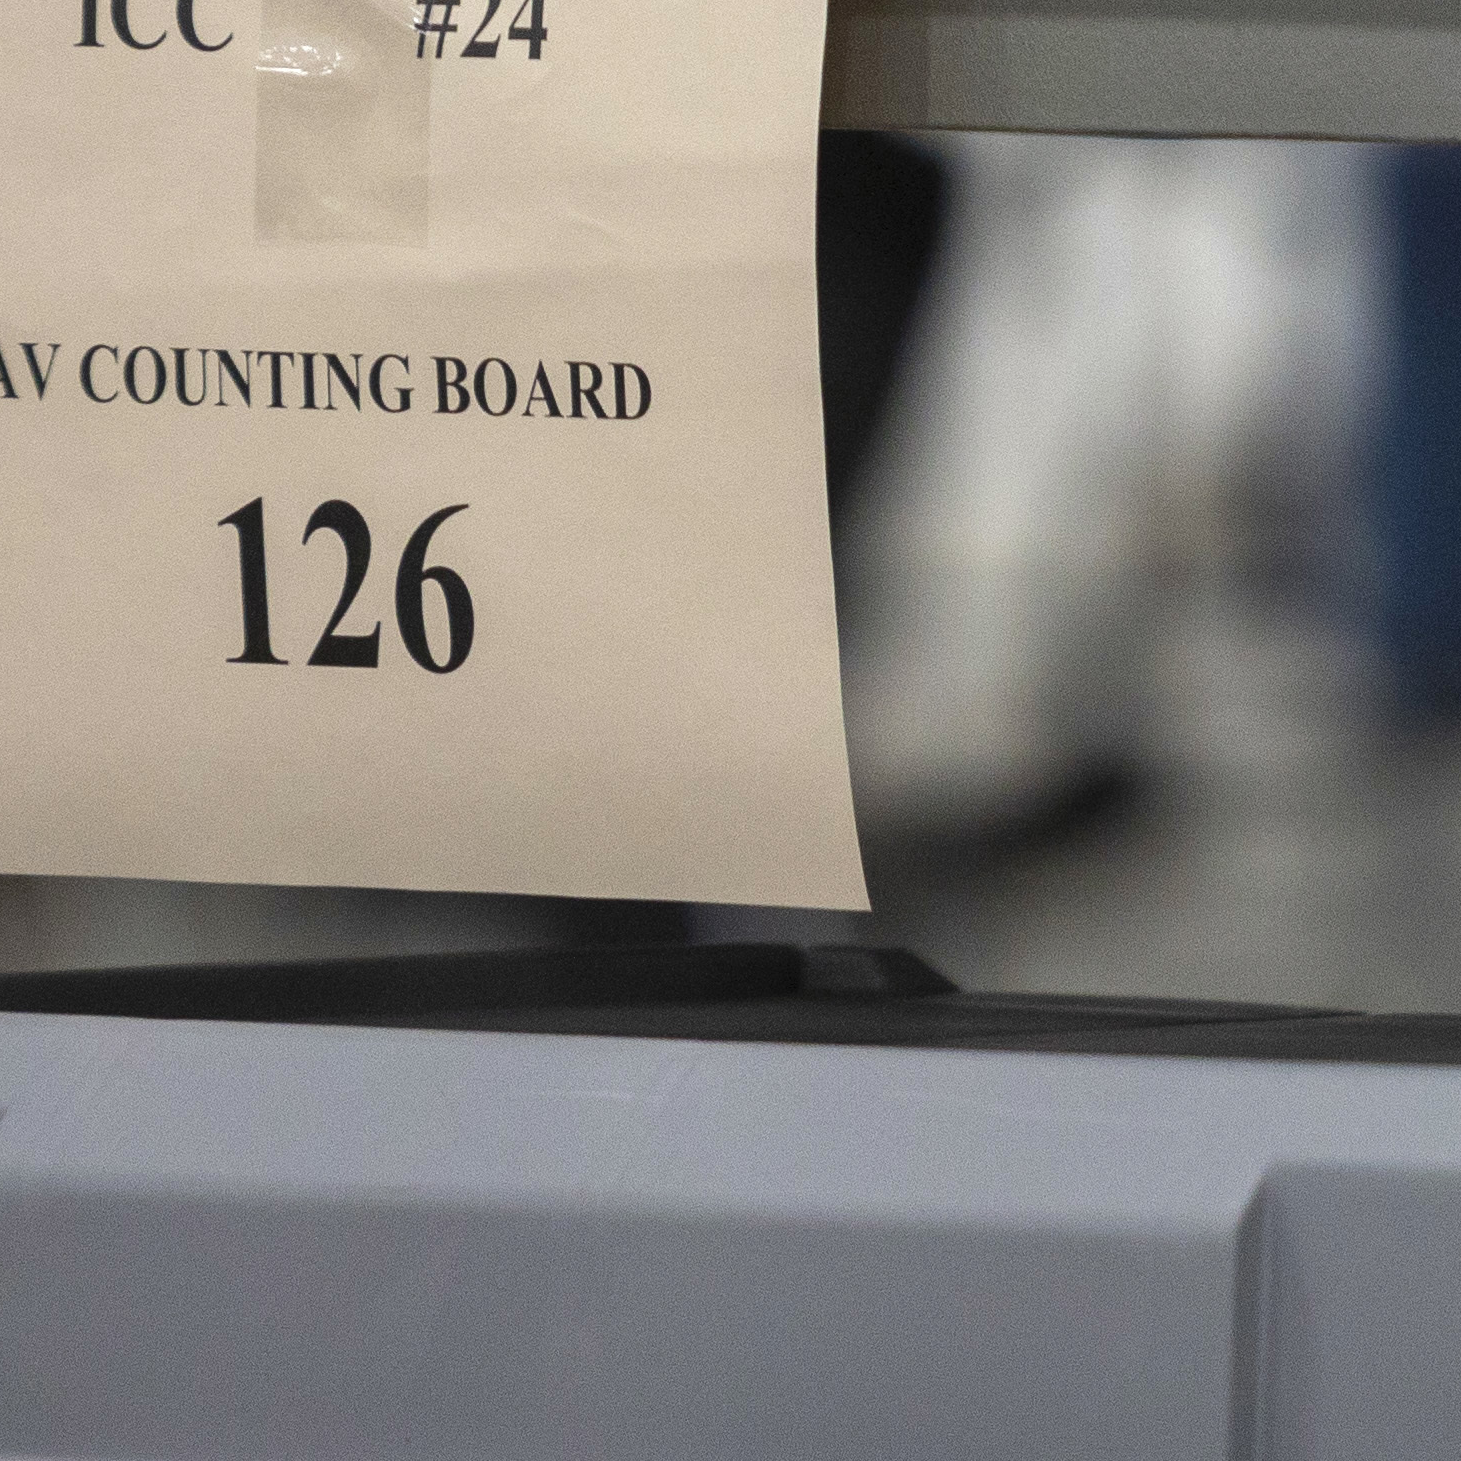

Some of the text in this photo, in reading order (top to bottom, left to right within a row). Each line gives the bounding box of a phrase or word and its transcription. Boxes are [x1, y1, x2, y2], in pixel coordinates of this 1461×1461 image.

[79, 344, 414, 414] COUNTING
[432, 356, 653, 421] BOARD
[216, 495, 476, 675] 126
